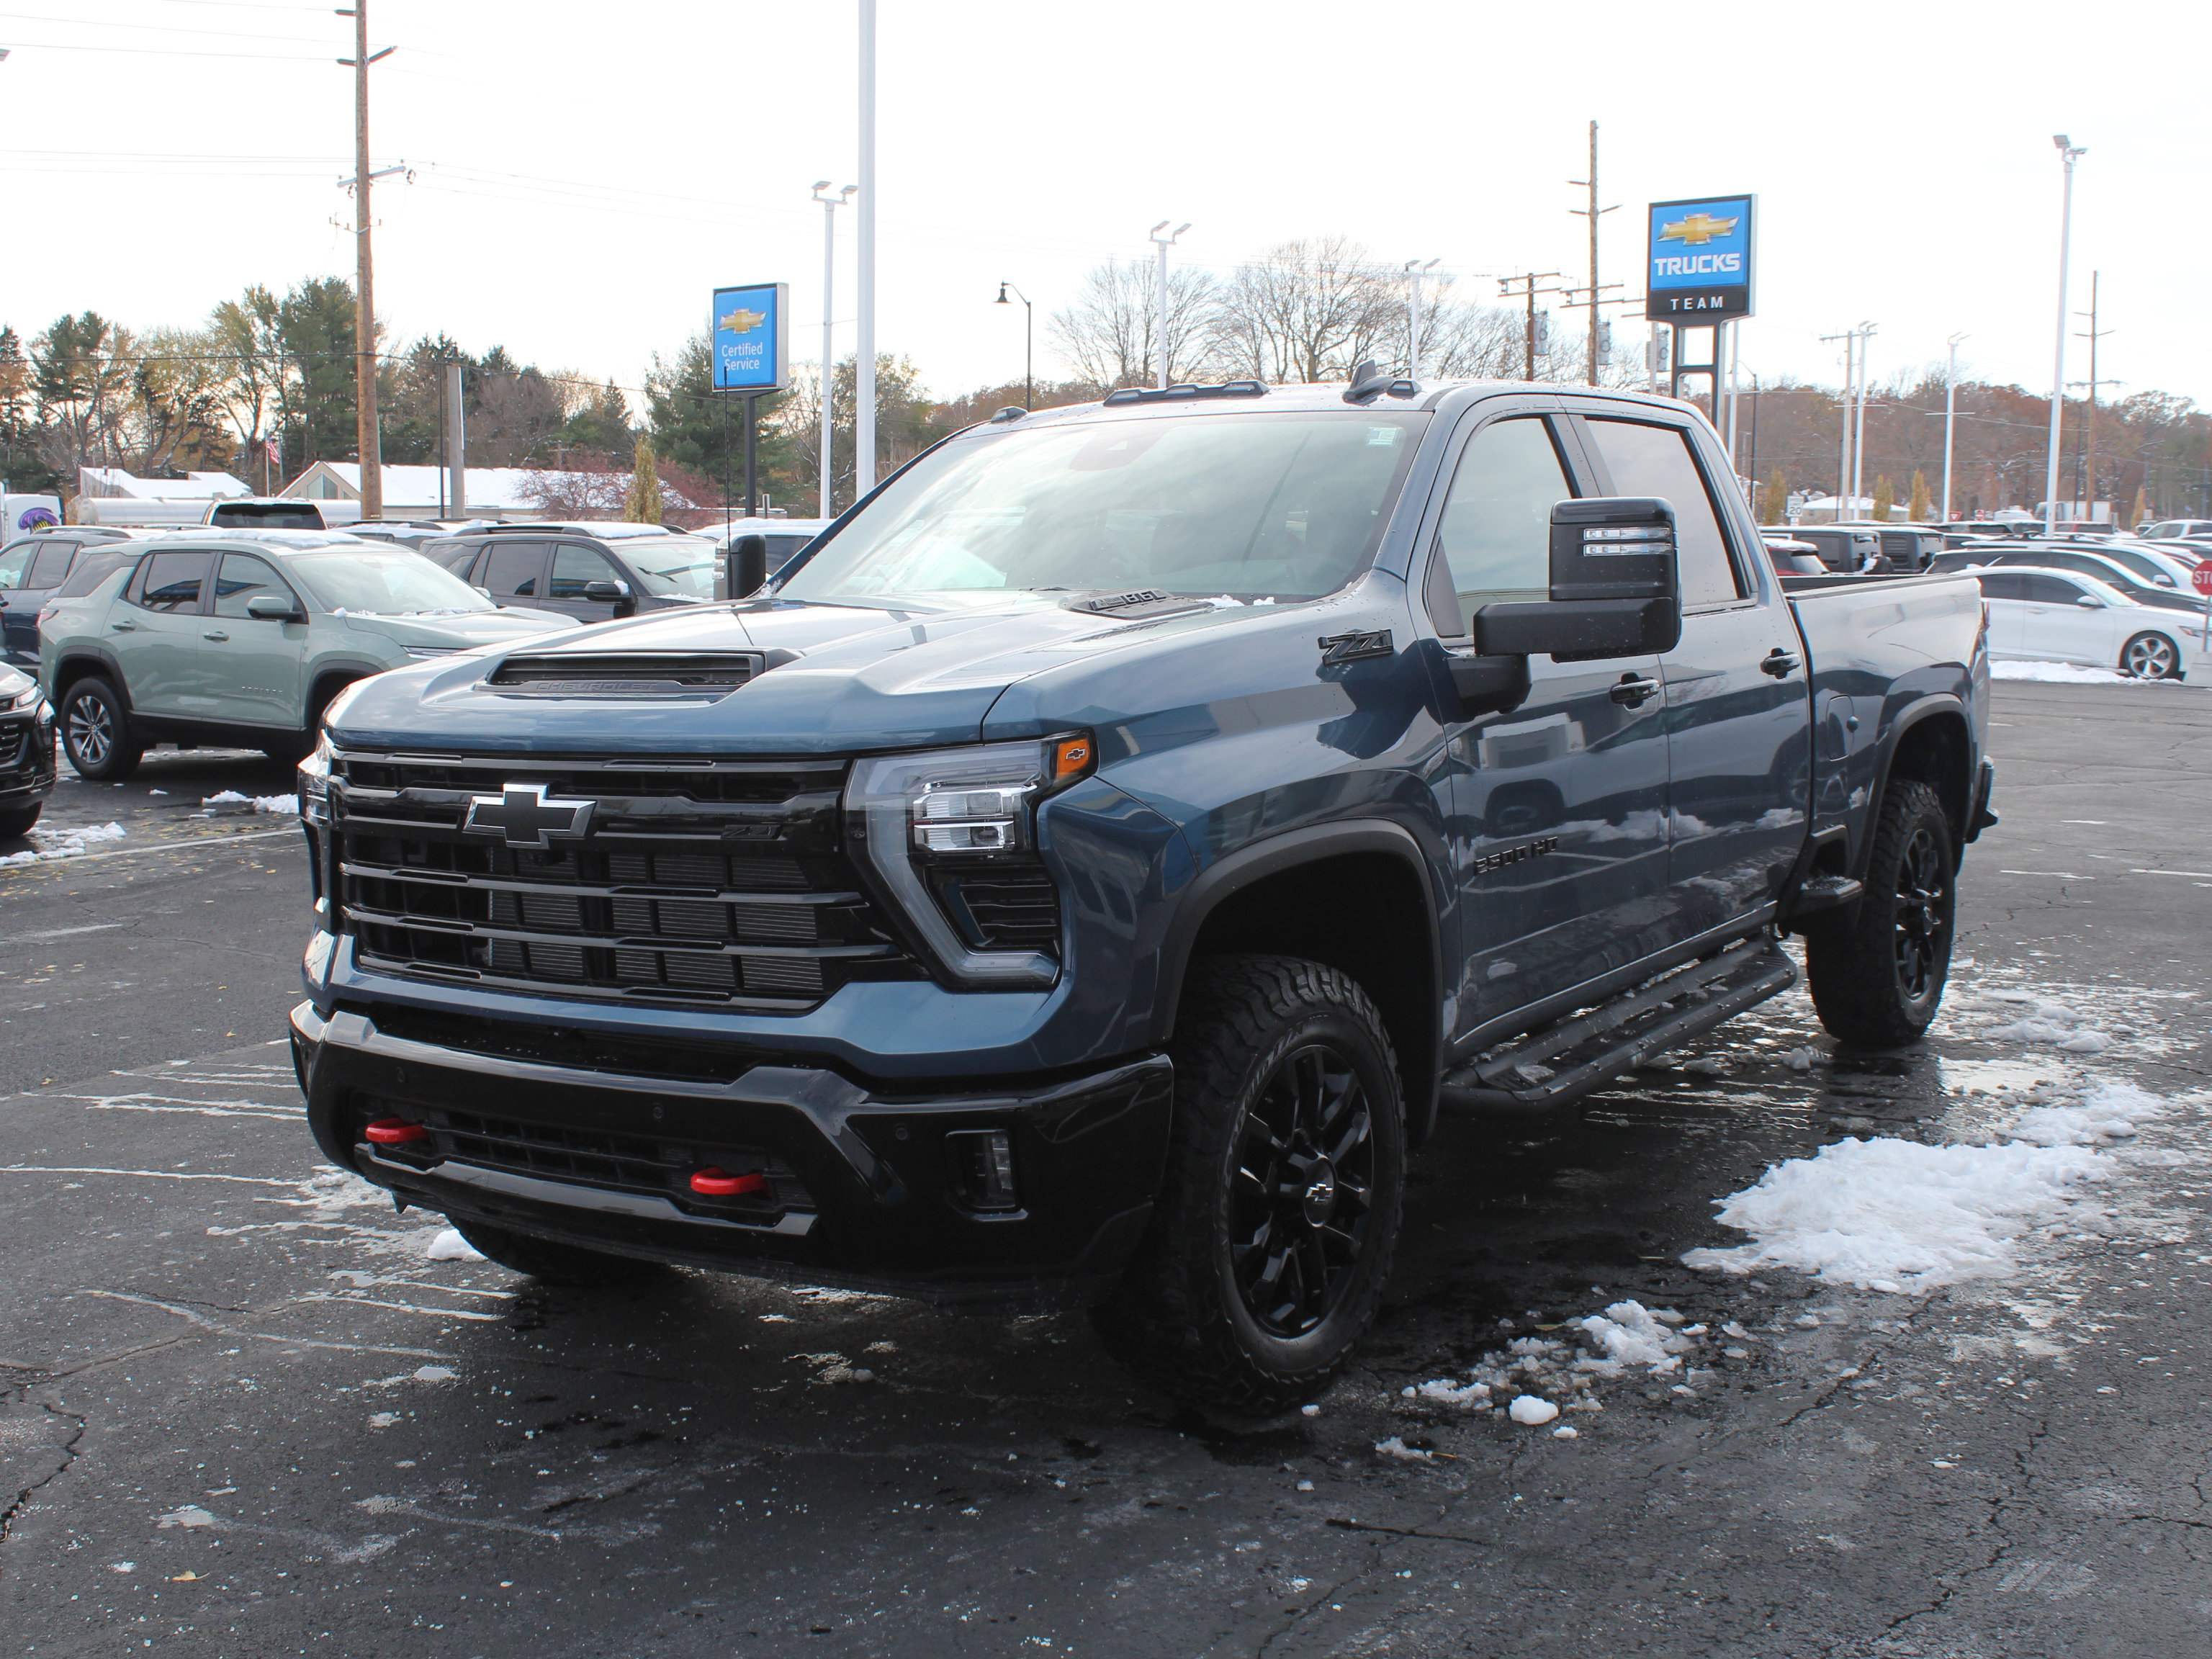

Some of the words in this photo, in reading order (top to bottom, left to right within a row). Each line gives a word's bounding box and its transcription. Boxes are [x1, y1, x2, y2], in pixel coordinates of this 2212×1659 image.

[1654, 253, 1740, 276] TRUCKS
[1670, 296, 1724, 310] TEAM
[721, 342, 763, 357] Certified
[724, 358, 760, 371] Service
[1789, 506, 1802, 515] 20
[1122, 589, 1166, 604] 6.6L
[1318, 629, 1394, 665] Z71
[536, 683, 657, 691] CHEVROLET
[1473, 845, 1526, 876] 2500
